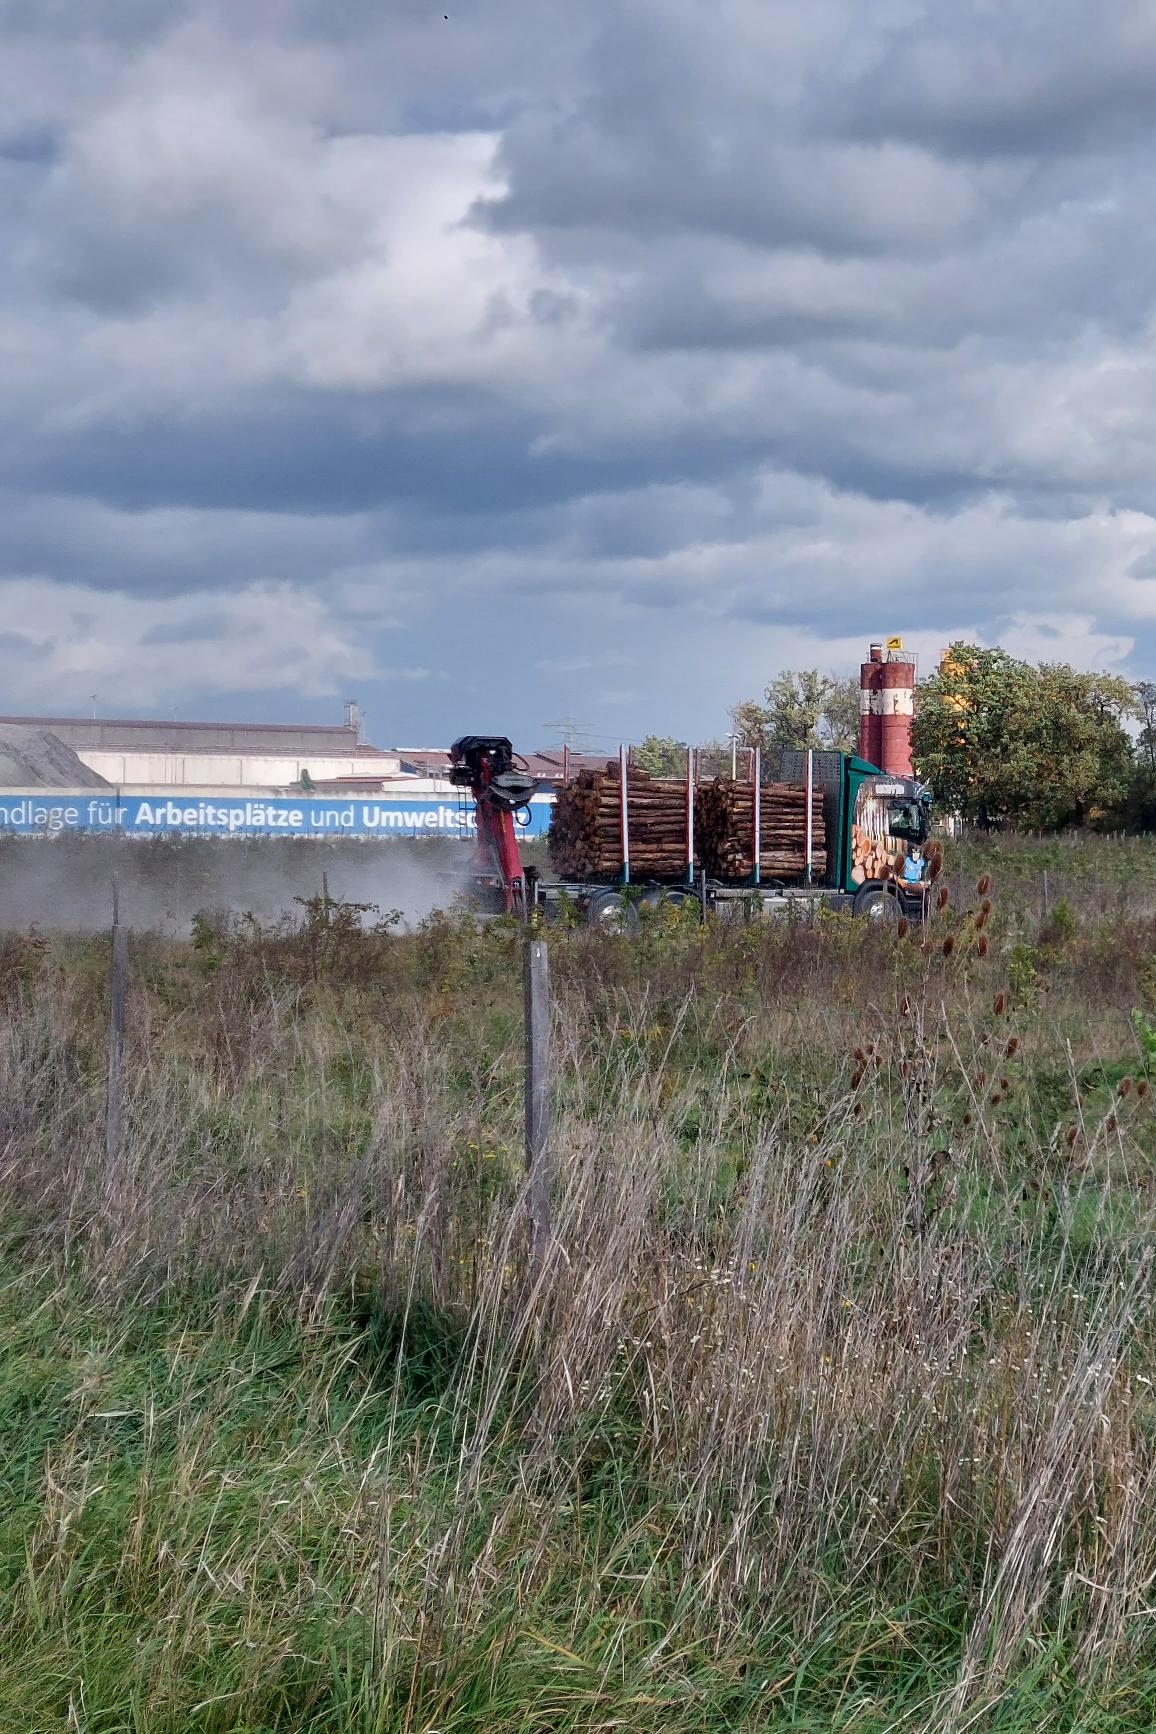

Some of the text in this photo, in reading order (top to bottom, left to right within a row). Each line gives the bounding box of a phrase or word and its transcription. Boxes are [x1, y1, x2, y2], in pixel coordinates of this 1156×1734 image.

[87, 800, 128, 825] für
[135, 802, 303, 831] Arbeitsplätze
[311, 804, 355, 827] und
[363, 805, 529, 828] Umweltscz
